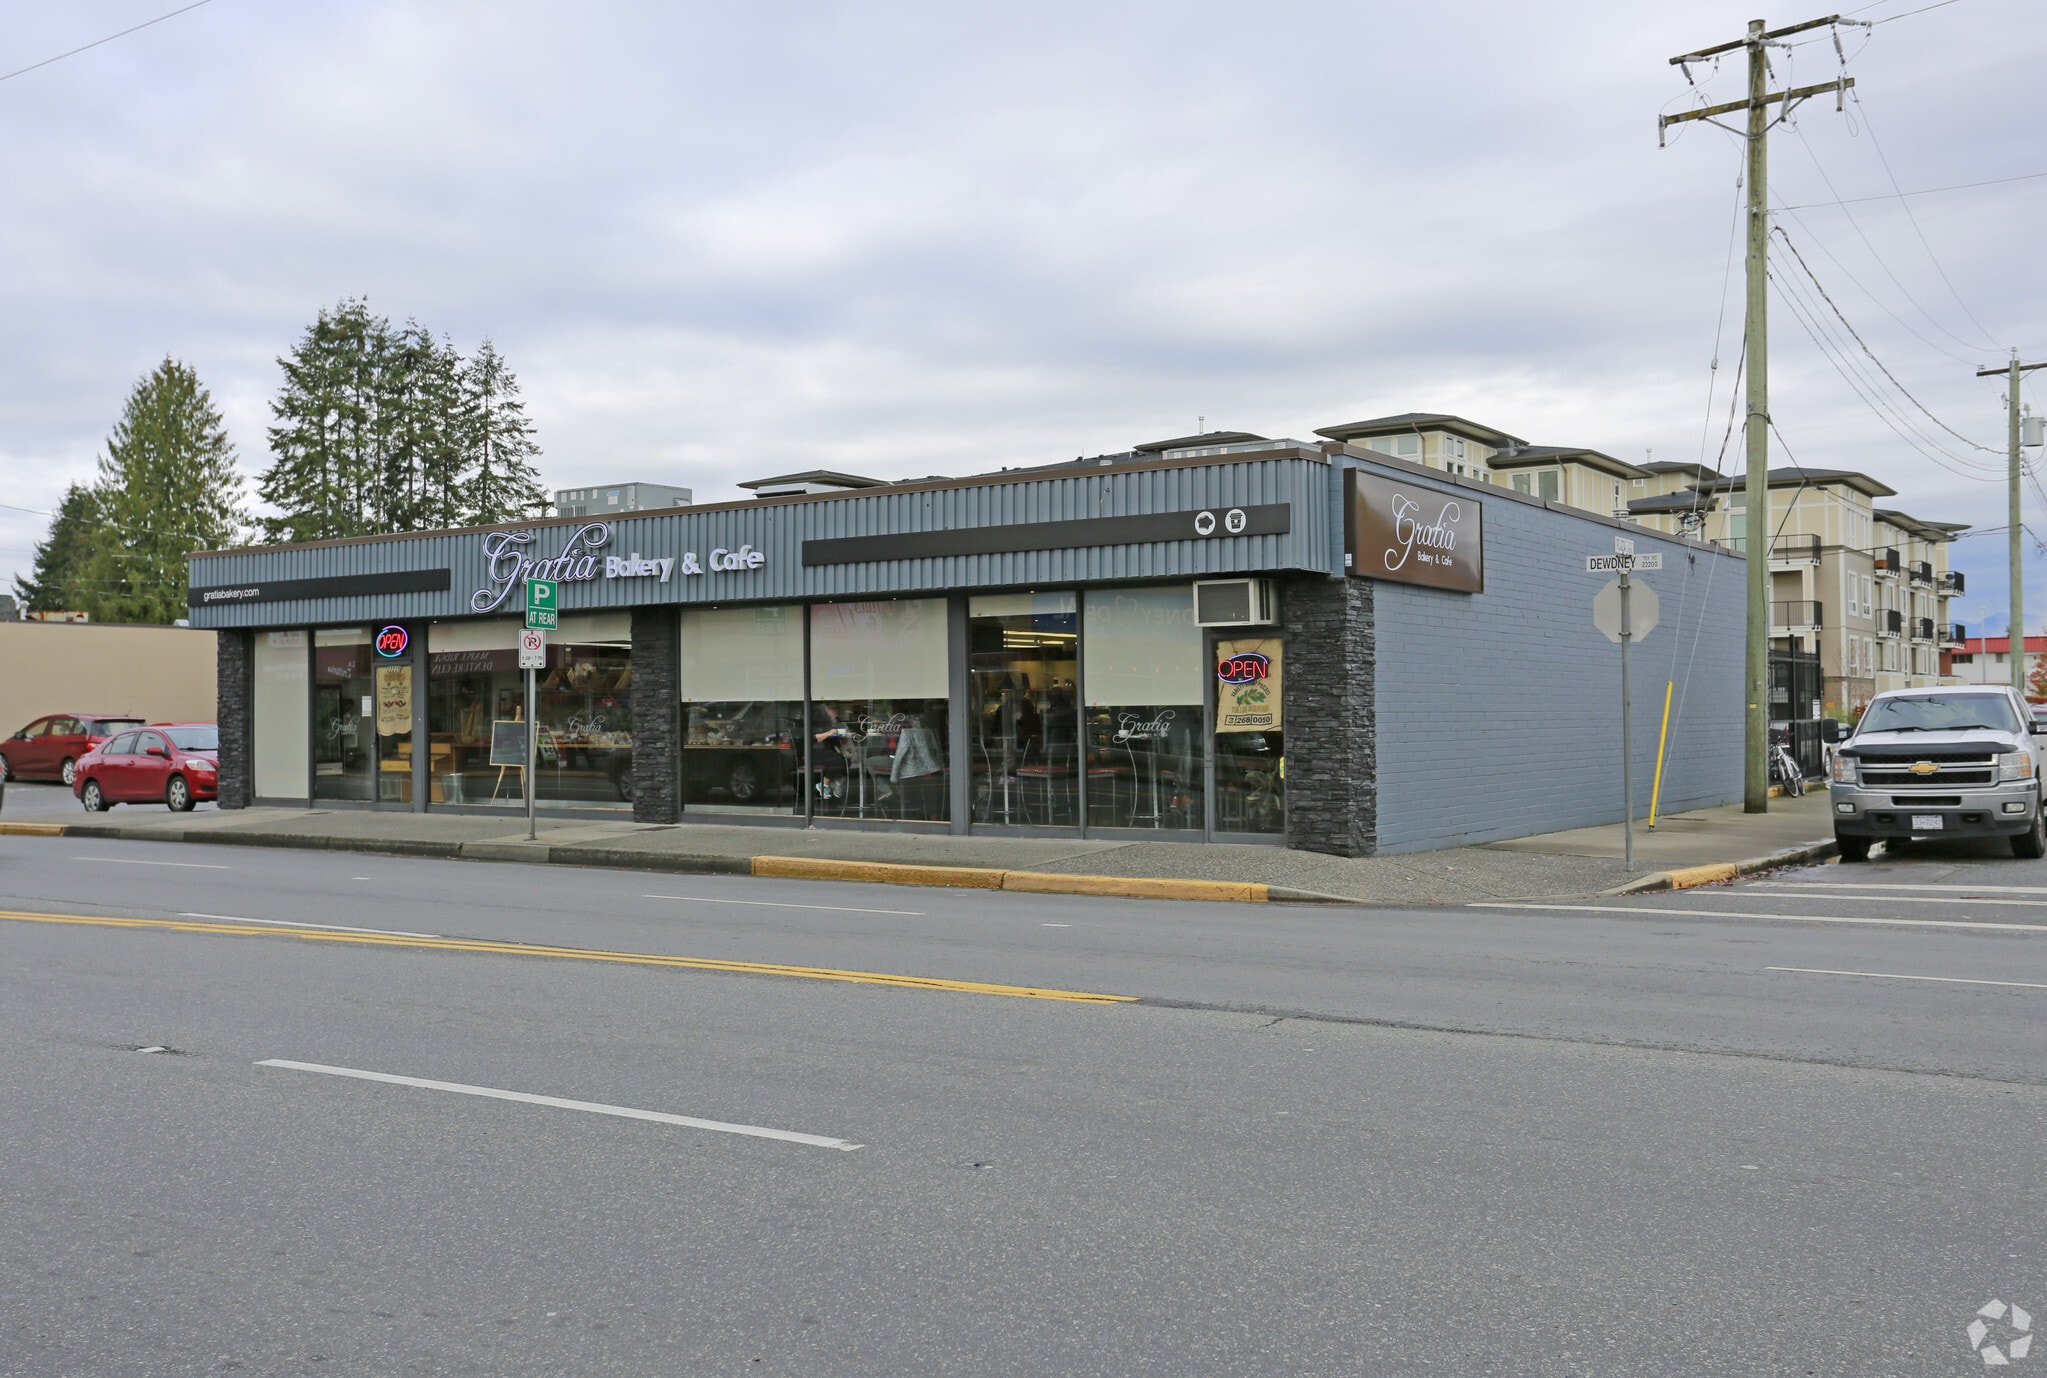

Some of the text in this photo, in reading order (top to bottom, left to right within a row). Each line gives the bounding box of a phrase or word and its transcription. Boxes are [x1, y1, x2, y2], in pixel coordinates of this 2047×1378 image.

[1384, 493, 1460, 571] Gratia
[471, 521, 765, 613] Gratia Bakery & Cafe
[1417, 551, 1453, 566] Bakery & Cafe
[1590, 557, 1636, 570] DEWDNEY
[203, 587, 260, 602] gratiabakery.com
[534, 583, 551, 605] P
[529, 611, 555, 625] AT REAR
[377, 633, 405, 650] OPEN
[1217, 659, 1267, 678] OPEN
[564, 715, 606, 741] Gratia
[853, 713, 906, 743] Gratia
[1112, 709, 1176, 744] Gratia
[1236, 716, 1251, 724] 268
[1252, 715, 1271, 723] 0050
